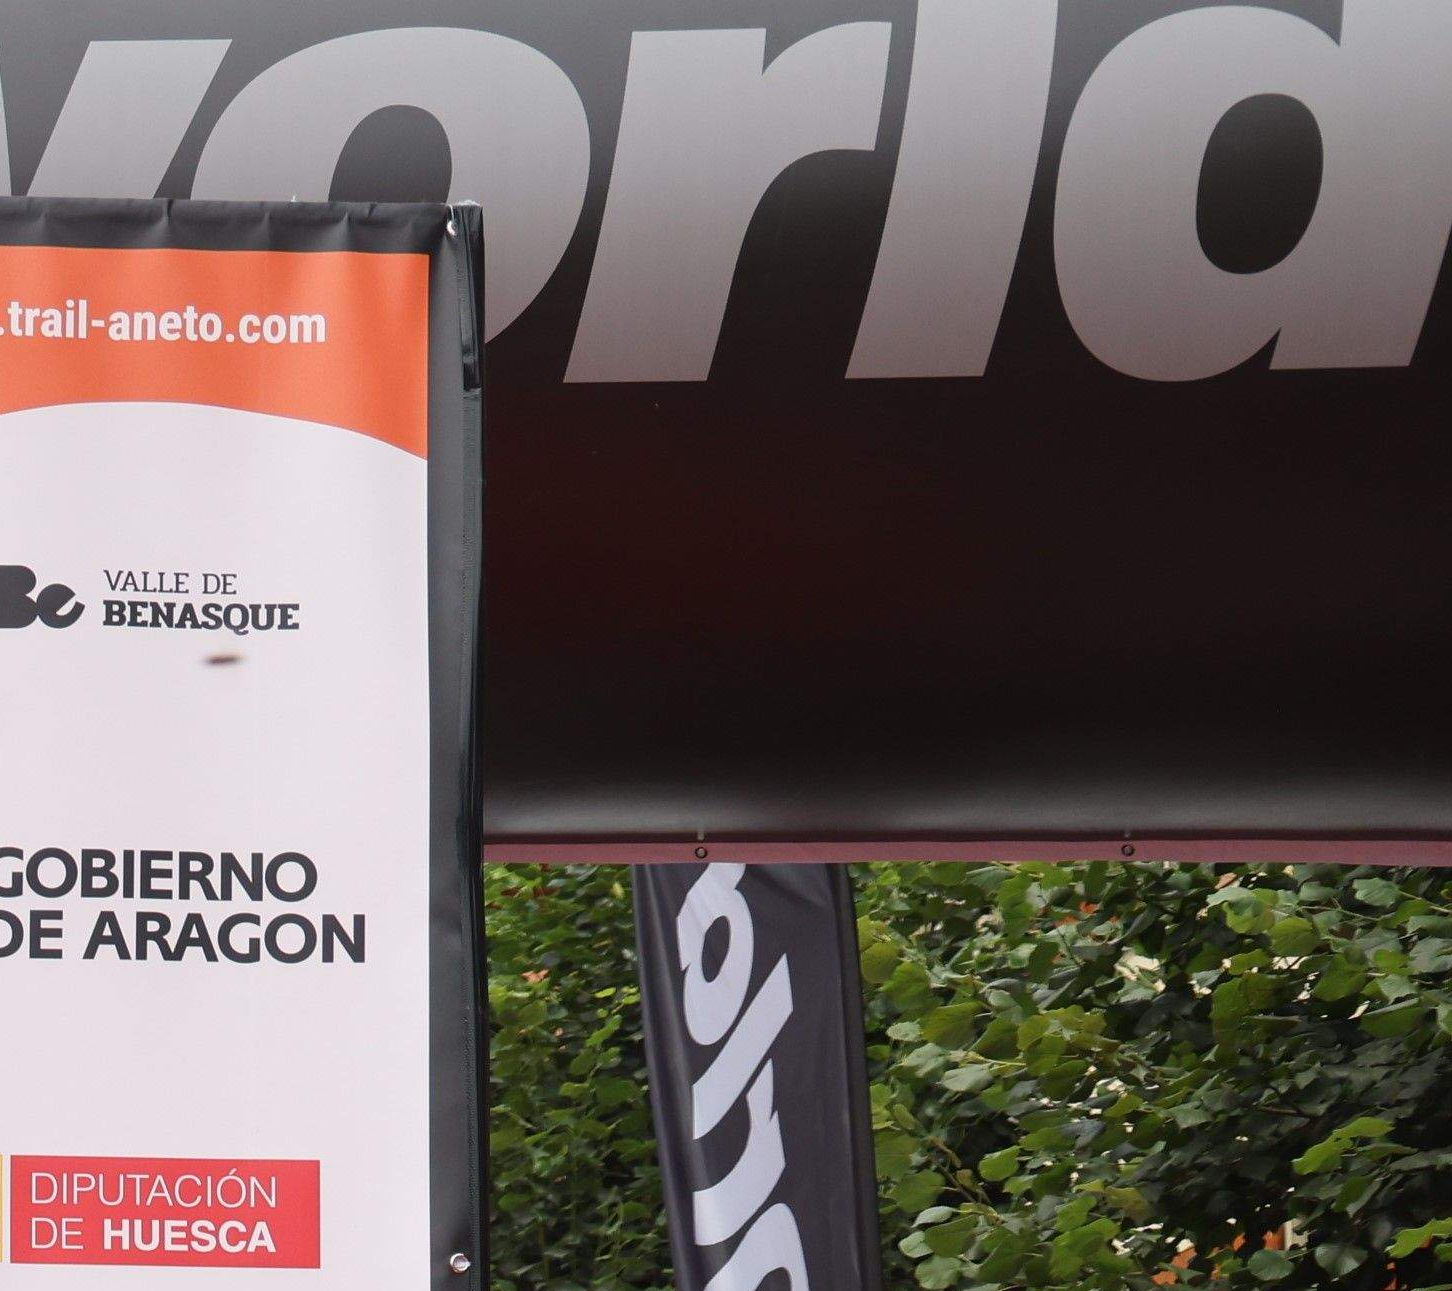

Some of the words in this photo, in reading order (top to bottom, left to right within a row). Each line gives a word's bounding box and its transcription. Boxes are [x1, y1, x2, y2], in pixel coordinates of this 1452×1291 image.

[103, 569, 190, 594] VALLE
[202, 573, 237, 595] DE
[102, 601, 300, 635] BENASQUE
[83, 912, 366, 964] ARAGON
[30, 1169, 277, 1209] DIPUTACIÓN
[30, 1219, 84, 1250] DE
[103, 1220, 276, 1253] HUESCA
